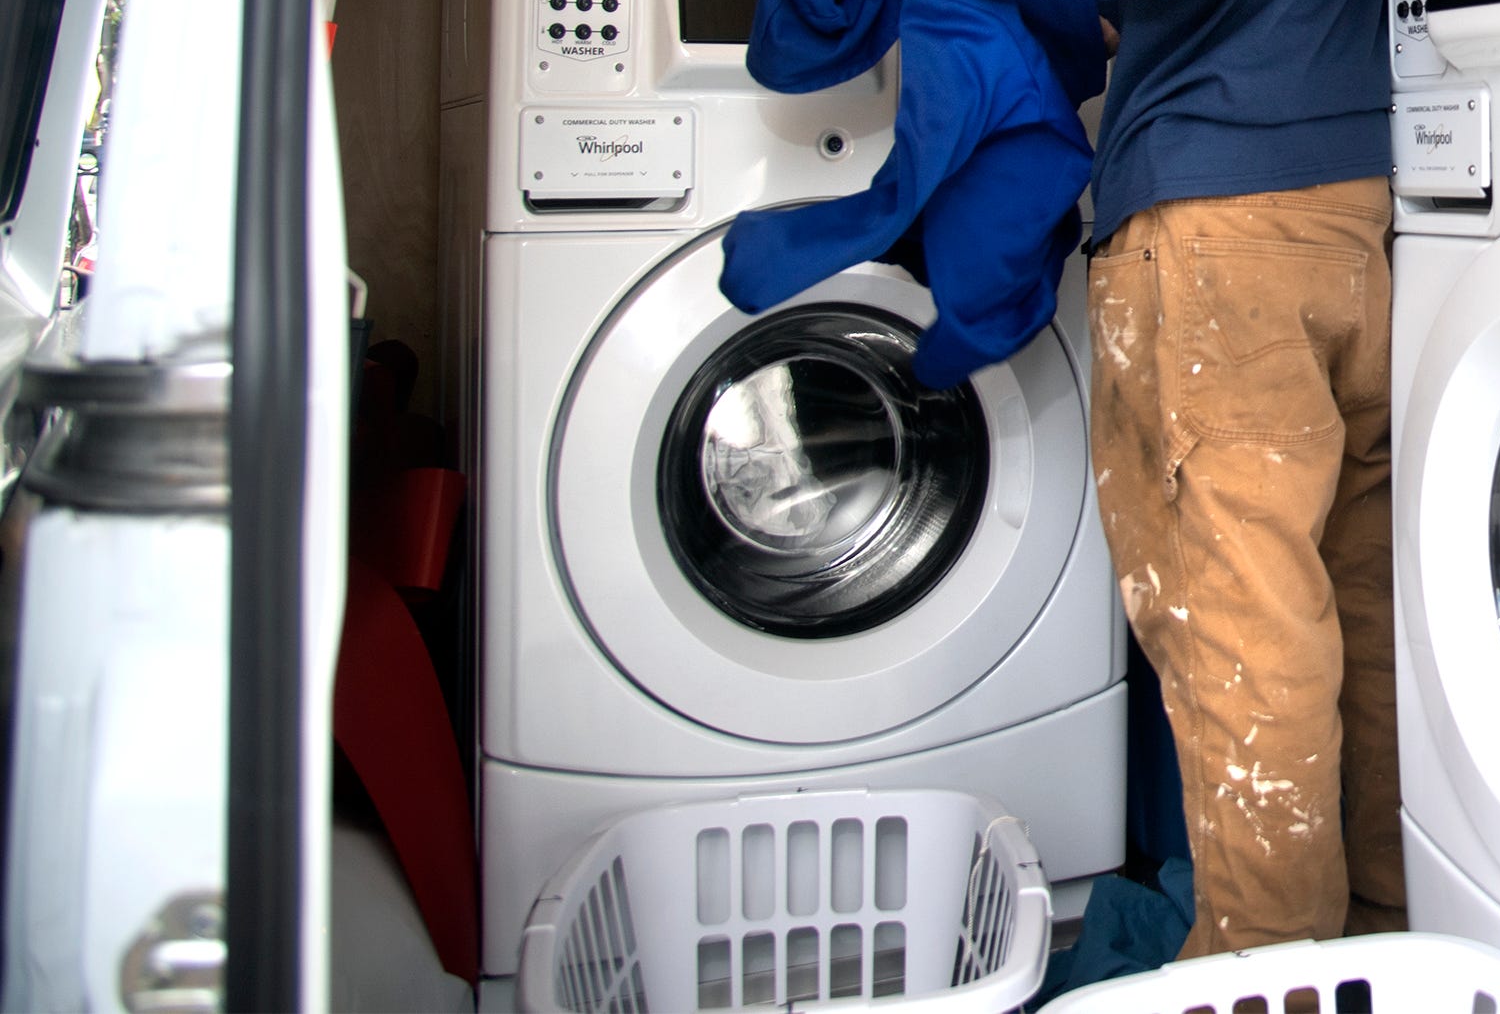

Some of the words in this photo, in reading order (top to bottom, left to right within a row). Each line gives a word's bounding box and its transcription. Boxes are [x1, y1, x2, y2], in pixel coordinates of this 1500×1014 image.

[1408, 24, 1428, 35] WASHE
[561, 46, 605, 56] WASHER
[1415, 130, 1452, 148] Whirlpool
[578, 141, 643, 157] Whirlpool
